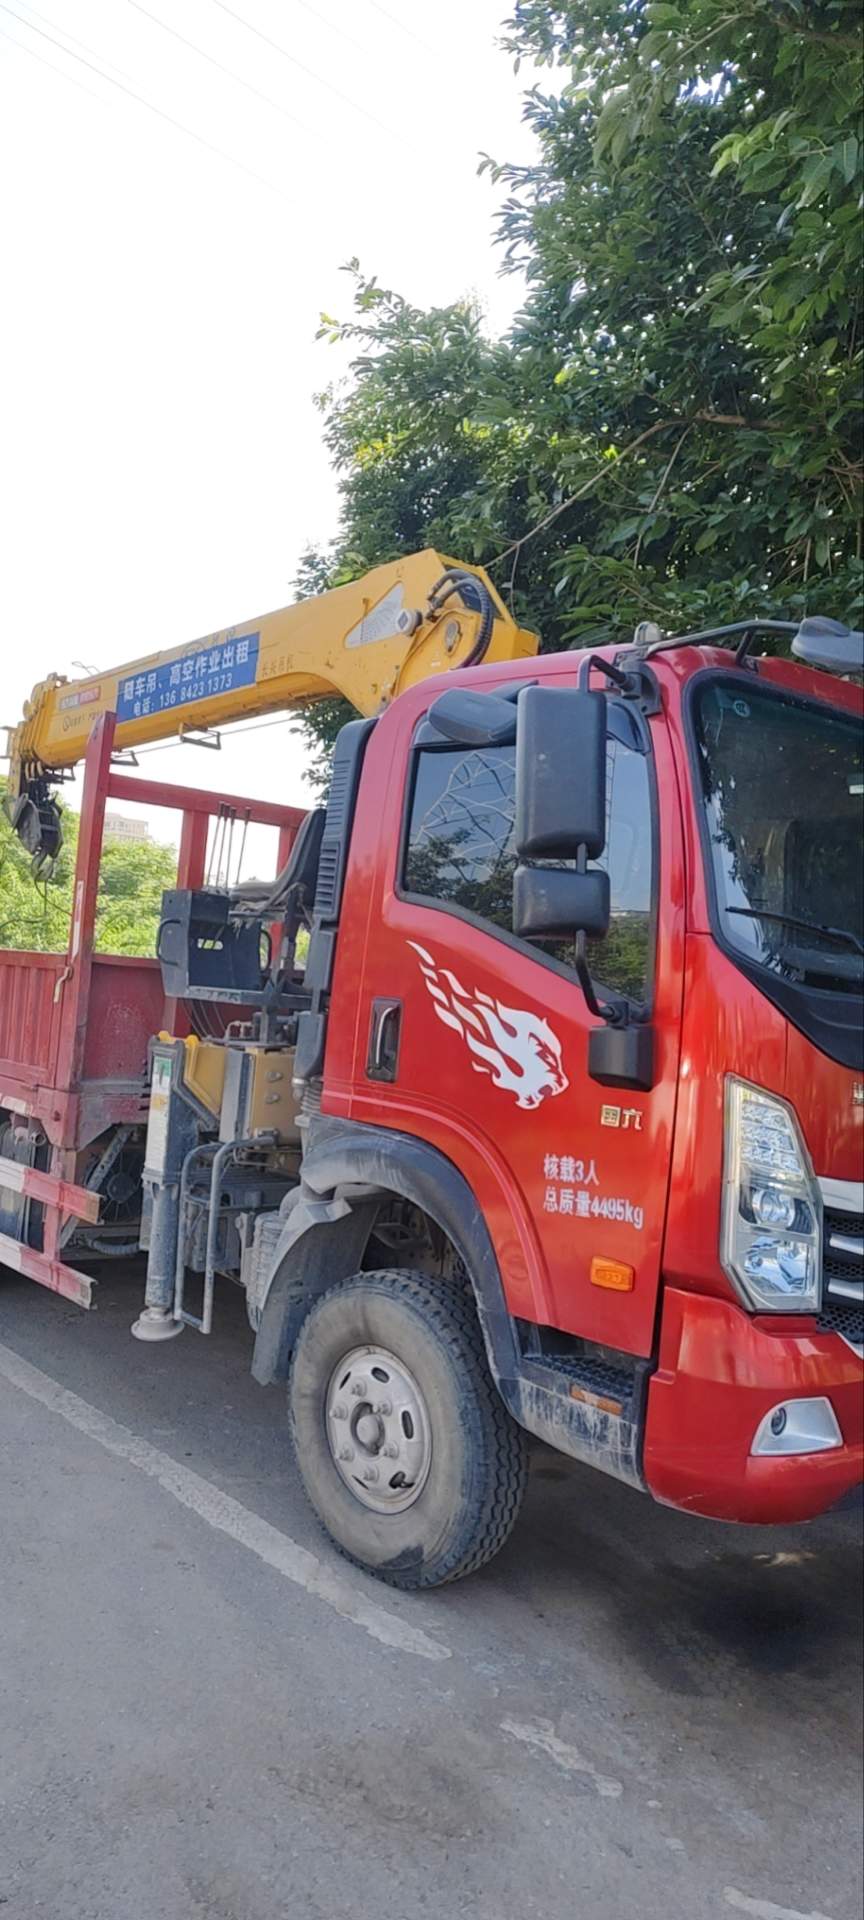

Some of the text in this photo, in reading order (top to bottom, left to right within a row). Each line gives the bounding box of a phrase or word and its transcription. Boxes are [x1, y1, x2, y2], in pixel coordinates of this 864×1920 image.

[601, 1104, 643, 1131] 国六
[543, 1153, 600, 1186] 核载3人
[543, 1186, 644, 1230] 总质量4495kg
